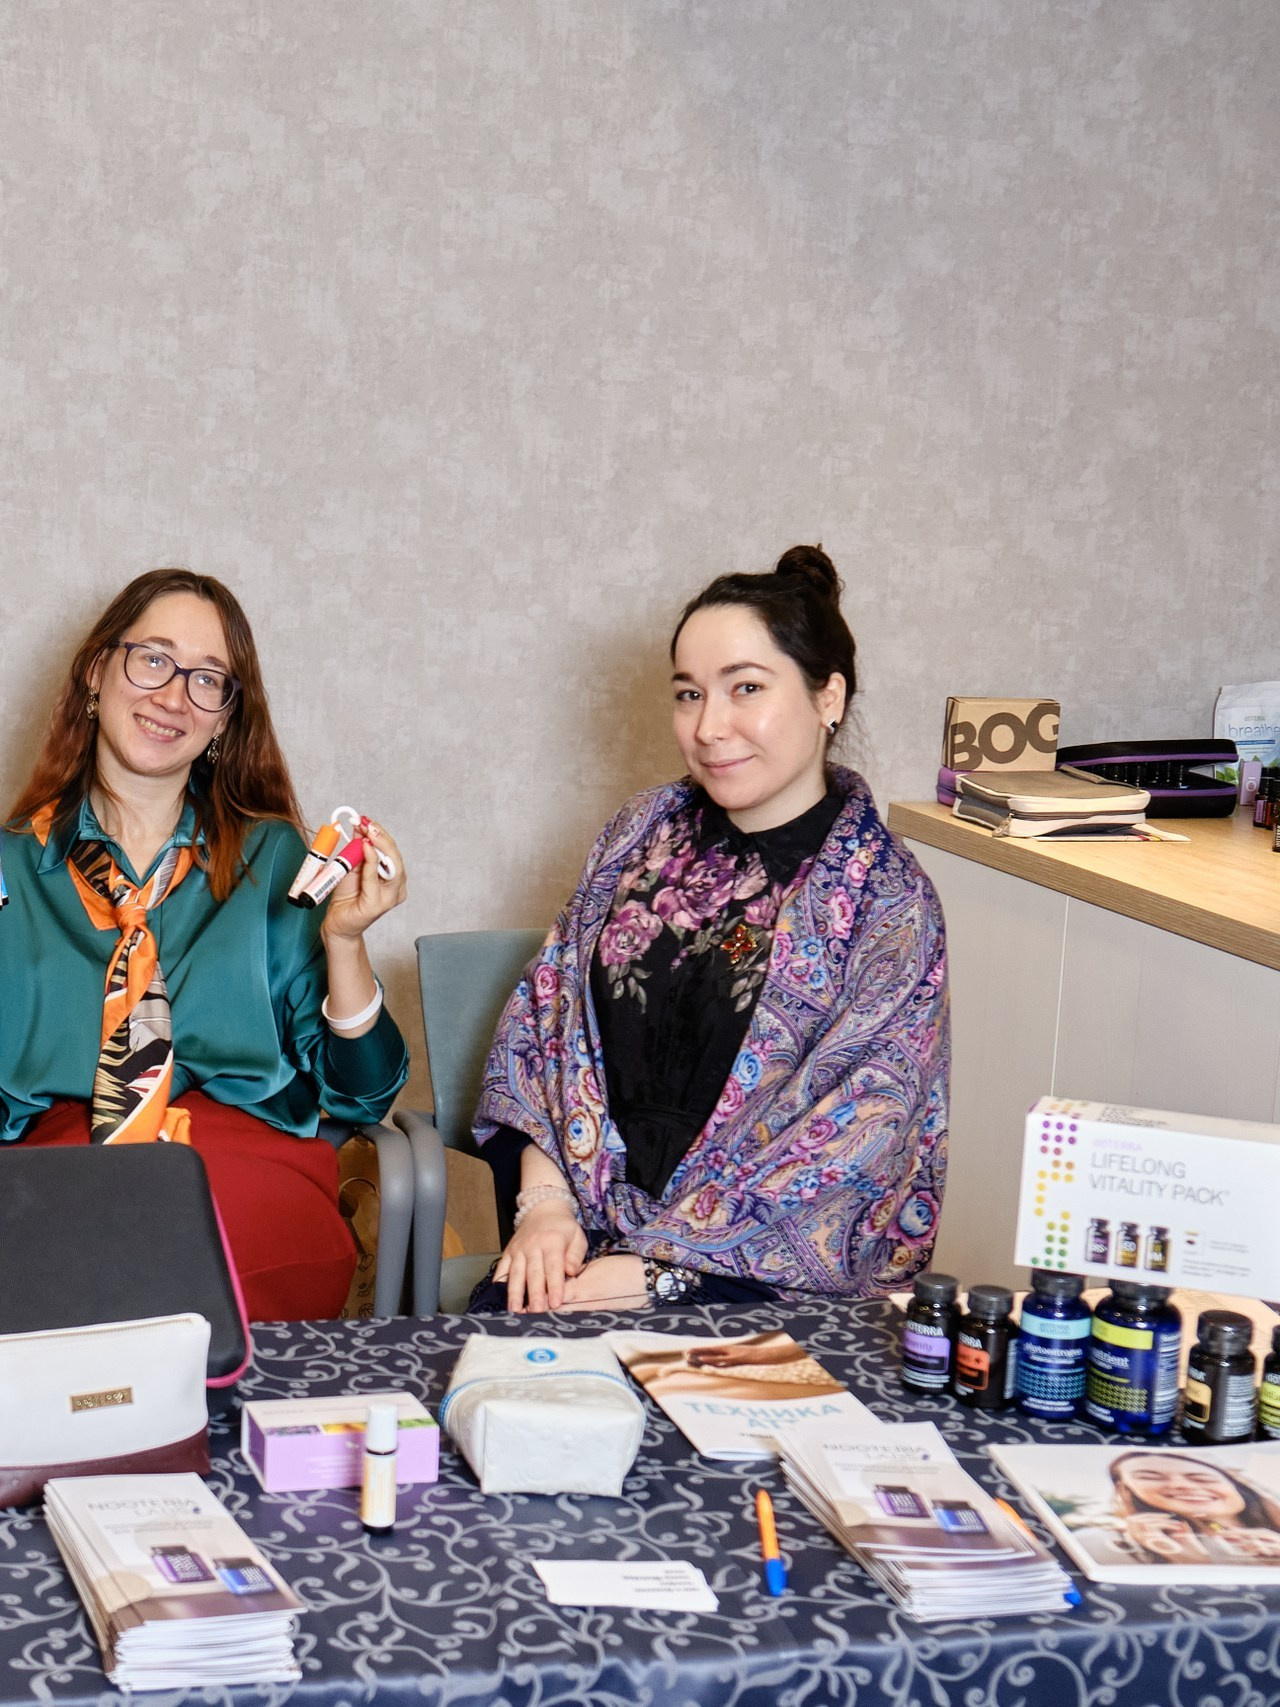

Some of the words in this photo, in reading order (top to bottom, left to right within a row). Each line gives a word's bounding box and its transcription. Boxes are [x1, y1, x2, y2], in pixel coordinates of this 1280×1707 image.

[1091, 1152, 1187, 1179] LIFELONG
[1089, 1173, 1169, 1198] VITALITY
[683, 1402, 843, 1418] ТЕХНИКА
